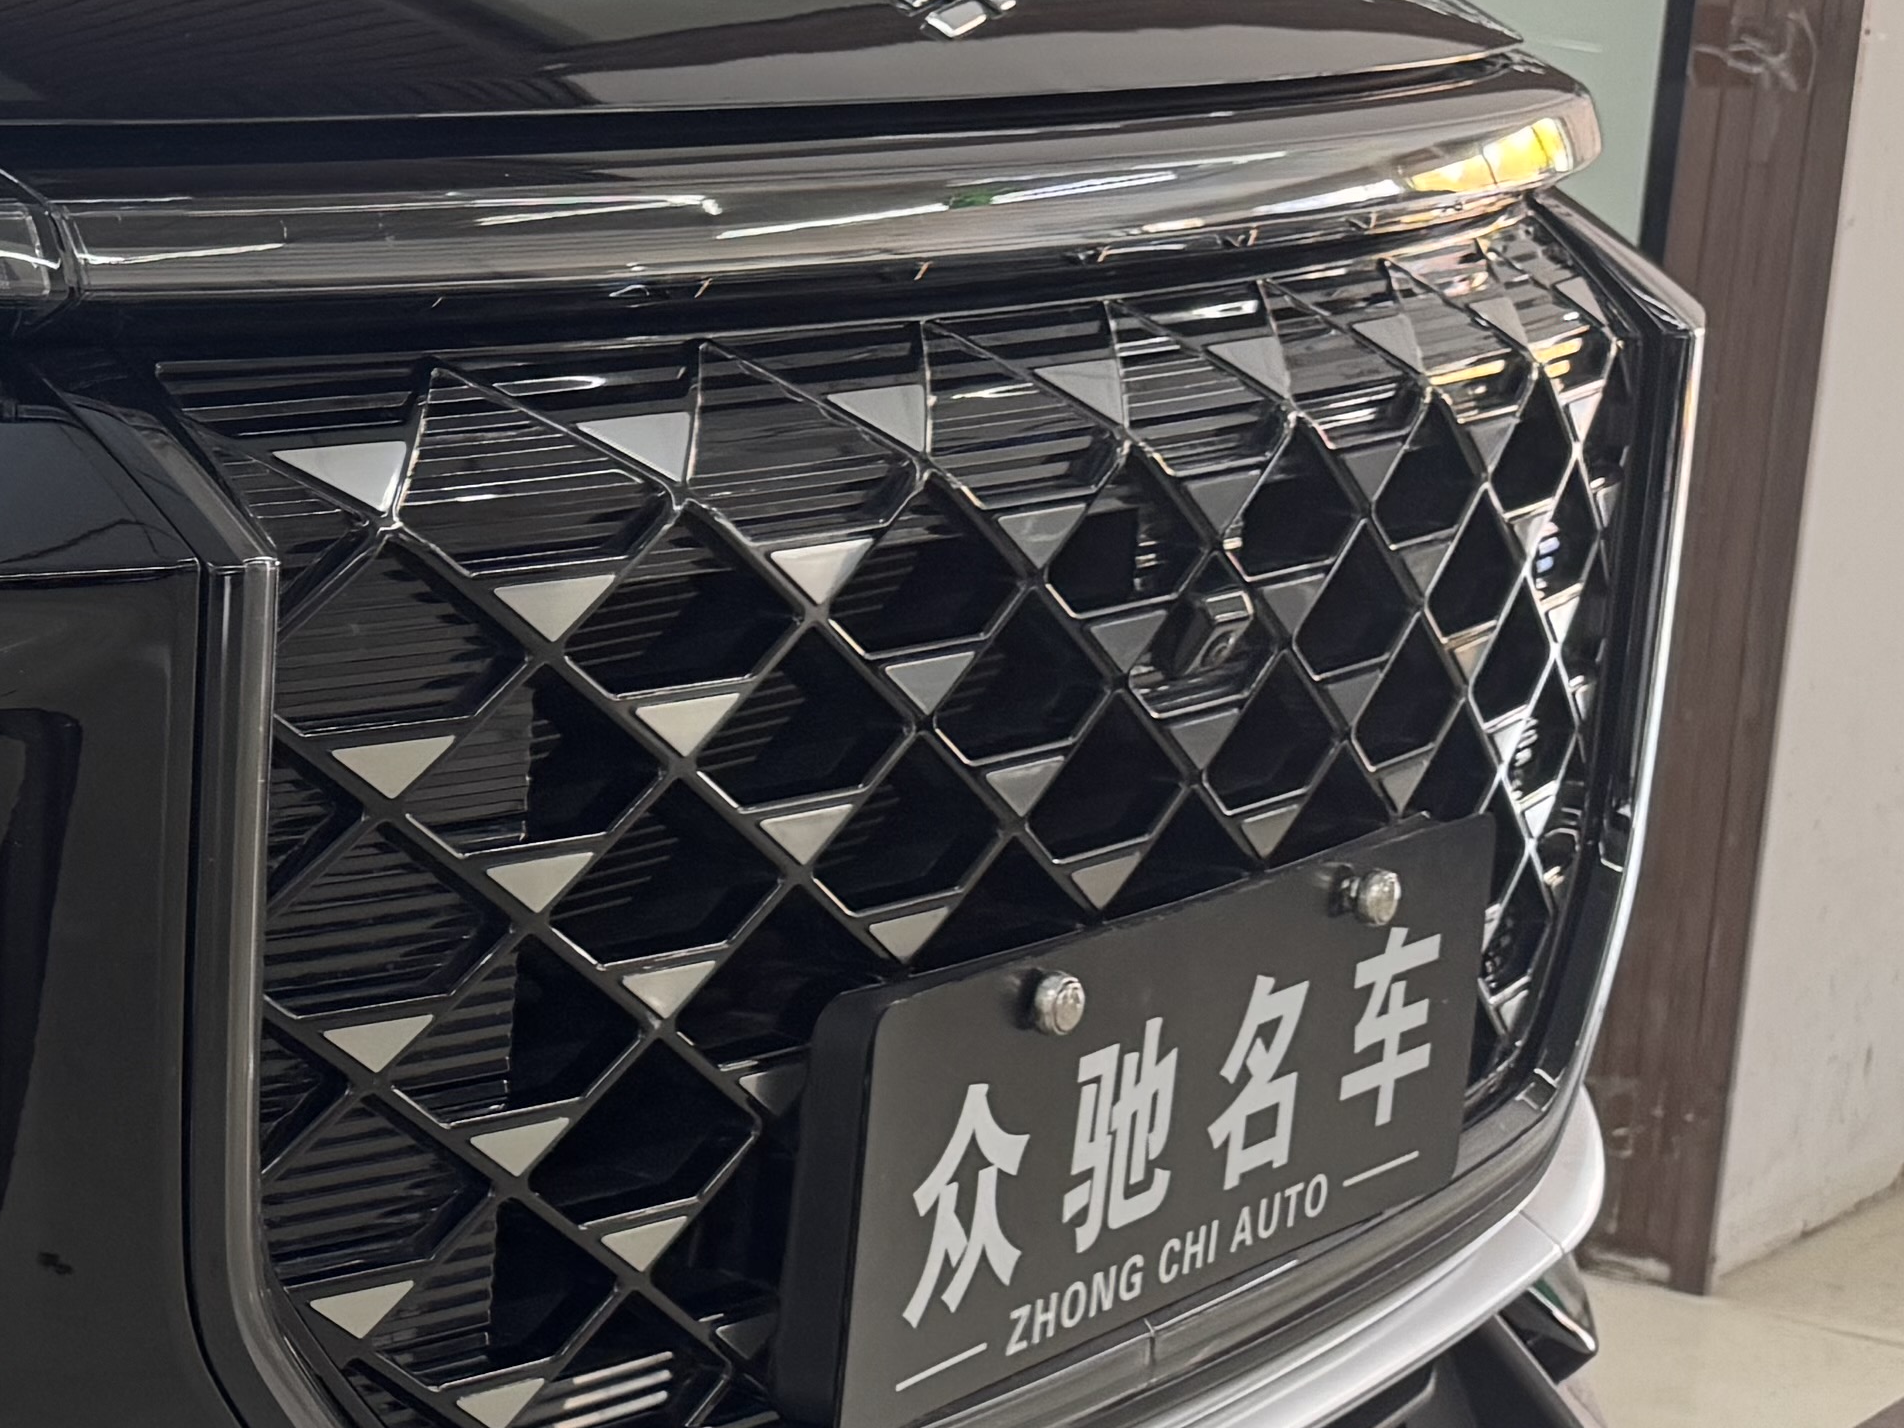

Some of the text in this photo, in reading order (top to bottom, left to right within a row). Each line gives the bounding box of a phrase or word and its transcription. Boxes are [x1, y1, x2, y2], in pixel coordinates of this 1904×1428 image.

[902, 926, 1442, 1329] 众驰名车
[1005, 1173, 1329, 1357] ZHONG CHI AUTO
